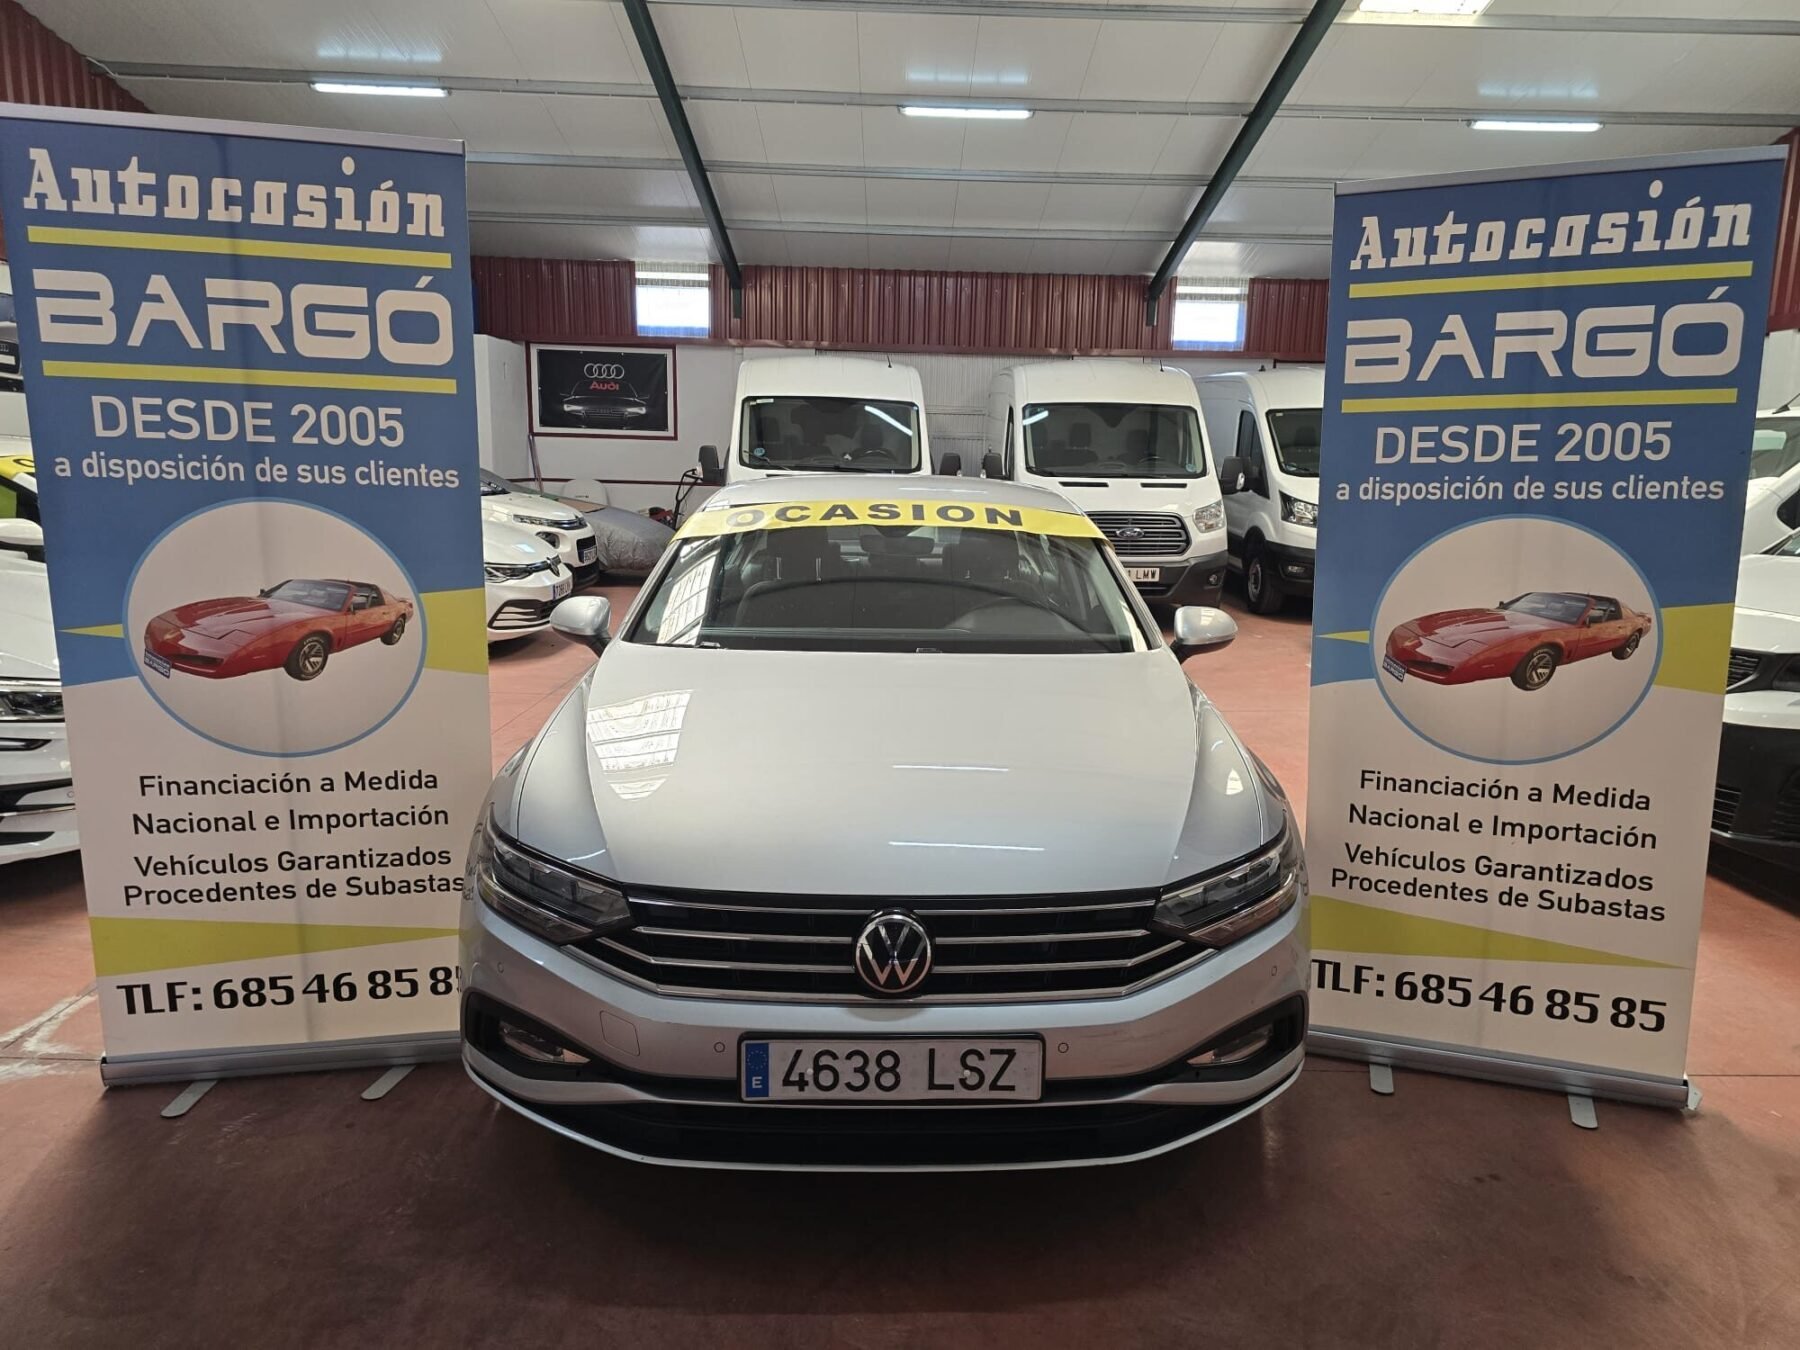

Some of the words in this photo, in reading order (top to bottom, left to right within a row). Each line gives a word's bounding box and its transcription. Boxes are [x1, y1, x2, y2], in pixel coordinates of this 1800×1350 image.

[24, 146, 445, 238] Autocasión
[1348, 179, 1753, 271] Autocasión
[32, 269, 453, 366] BARGÓ
[1344, 286, 1744, 384] BARGÓ
[92, 396, 275, 442] DESDE
[291, 404, 404, 447] 2005
[1376, 424, 1540, 464] DESDE
[1555, 422, 1672, 461] 2005
[55, 458, 71, 476] a
[83, 451, 244, 485] disposición
[256, 457, 287, 482] de
[297, 465, 346, 484] sus
[355, 460, 459, 488] clientes
[1337, 483, 1349, 500] a
[1360, 476, 1503, 506] disposición
[1514, 476, 1544, 499] de
[1554, 482, 1602, 499] sus
[1612, 475, 1724, 499] clientes
[726, 502, 1024, 528] OCASION
[1136, 569, 1157, 580] LMW
[140, 773, 310, 796] Financiación
[321, 778, 334, 792] a
[345, 770, 437, 791] Medida
[1361, 770, 1518, 800] Financiación
[1528, 787, 1542, 802] a
[1553, 784, 1650, 810] Medida
[133, 811, 256, 834] Nacional
[265, 816, 279, 830] e
[290, 805, 448, 834] Importación
[1350, 803, 1459, 832] Nacional
[1469, 819, 1482, 834] e
[1493, 816, 1656, 849] Importación
[134, 853, 268, 876] Vehículos
[278, 846, 451, 871] Garantizados
[1344, 843, 1465, 875] Vehículos
[1475, 856, 1653, 892] Garantizados
[124, 882, 296, 906] Procedentes
[307, 878, 336, 898] de
[345, 871, 465, 898] Subastas
[1332, 868, 1490, 903] Procedentes
[1499, 886, 1528, 907] de
[1537, 888, 1664, 921] Subastas
[117, 982, 202, 1014] TLF:
[214, 976, 294, 1009] 685
[302, 973, 357, 1003] 46
[368, 969, 418, 999] 85
[428, 964, 462, 996] 8
[1311, 958, 1385, 998] TLF:
[1395, 972, 1472, 1007] 685
[1479, 982, 1533, 1015] 46
[1545, 989, 1599, 1023] 85
[1611, 997, 1666, 1032] 85
[752, 1077, 762, 1088] E
[781, 1048, 901, 1092] 4638
[927, 1048, 1016, 1092] LSZ
